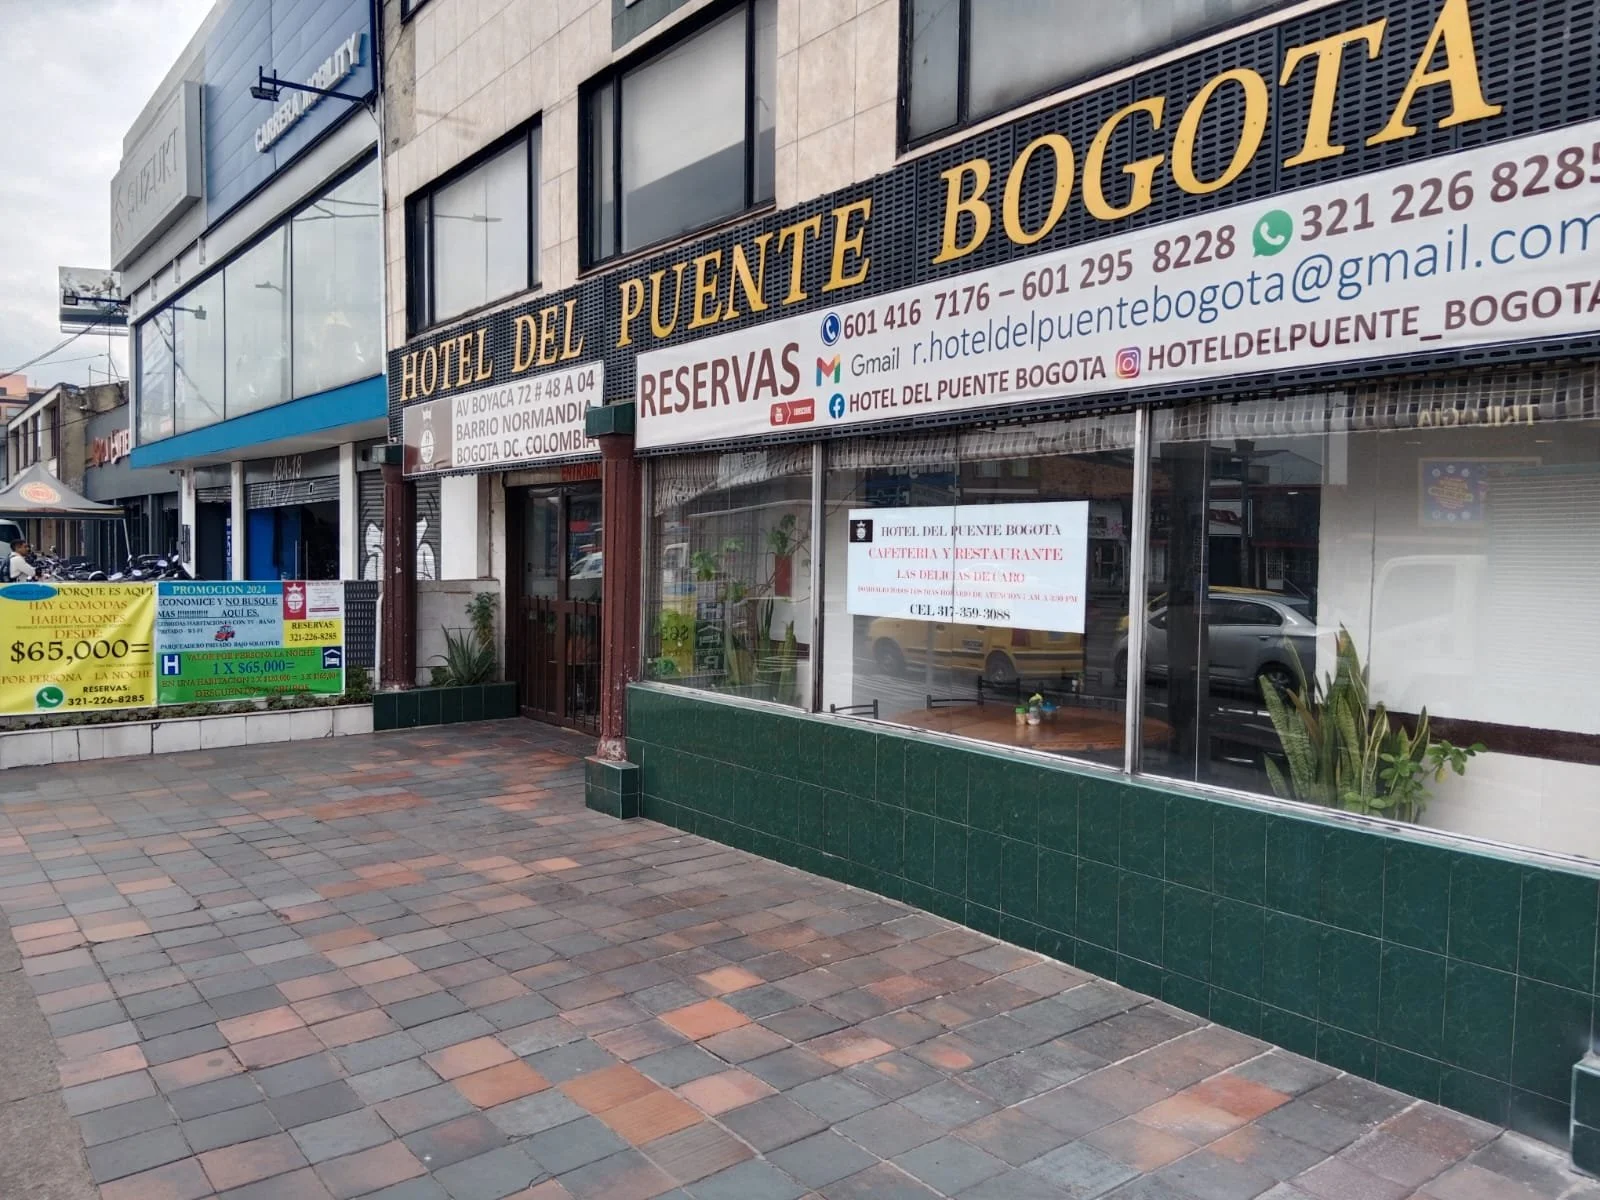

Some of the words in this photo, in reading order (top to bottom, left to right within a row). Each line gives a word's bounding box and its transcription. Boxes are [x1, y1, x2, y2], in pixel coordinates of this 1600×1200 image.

[255, 92, 302, 153] CARRERA
[400, 328, 494, 401] HOTEL
[511, 299, 585, 374] DEL
[616, 198, 873, 347] PUENTE
[933, 0, 1502, 265] BOGOTA
[1301, 193, 1375, 243] 321
[1391, 170, 1474, 224] 226
[843, 310, 878, 340] 601
[884, 299, 921, 330] 416
[935, 282, 990, 320] 7176
[1022, 264, 1070, 301] 601
[1080, 249, 1133, 288] 295
[1152, 224, 1236, 274] 8228
[851, 347, 900, 377] Gmail
[913, 213, 1600, 367] r.hoteldelpuentebogota@gmail.com
[641, 342, 801, 419] RESERVAS
[849, 389, 898, 413] HOTEL
[903, 383, 932, 406] DEL
[938, 370, 1009, 401] PUENTE
[1016, 356, 1106, 391] BOGOTA
[456, 400, 470, 418] AV
[472, 388, 514, 415] BOYACA
[518, 384, 532, 405] 72
[535, 383, 543, 401] #
[545, 377, 561, 398] 48
[564, 375, 574, 396] A
[577, 370, 595, 393] 04
[456, 418, 499, 442] BARRIO
[457, 441, 500, 465] BOGOTA
[504, 439, 523, 459] DC.
[561, 463, 599, 481] ENTRADA
[881, 526, 920, 537] HOTEL
[922, 525, 948, 537] DEL
[951, 524, 1002, 537] PUENTE
[1006, 524, 1062, 536] BOGOTA
[868, 547, 938, 559] CAFETERIA
[943, 547, 952, 560] Y
[955, 547, 1063, 561] RESTAURANTE
[897, 569, 916, 579] LAS
[920, 570, 971, 581] DELICAS
[57, 587, 105, 597] PORQUE
[109, 587, 121, 596] ES
[173, 586, 244, 595] PROMOCION
[247, 585, 266, 594] 2024
[29, 601, 55, 610] HAY
[59, 600, 128, 610] COMODAS
[226, 598, 240, 606] NO
[242, 598, 278, 606] BUSQUE
[31, 614, 126, 625] HABITACIONES
[910, 604, 935, 616] CEL
[937, 606, 1011, 620] 317-359-3088
[289, 632, 337, 642] 321-226-8285
[10, 639, 150, 665] $65,000=
[223, 662, 235, 674] X
[1, 675, 27, 684] POR
[30, 673, 82, 683] PERSONA
[95, 672, 108, 680] LA
[112, 670, 152, 679] NOCHE
[68, 694, 145, 706] 321-226-8285
